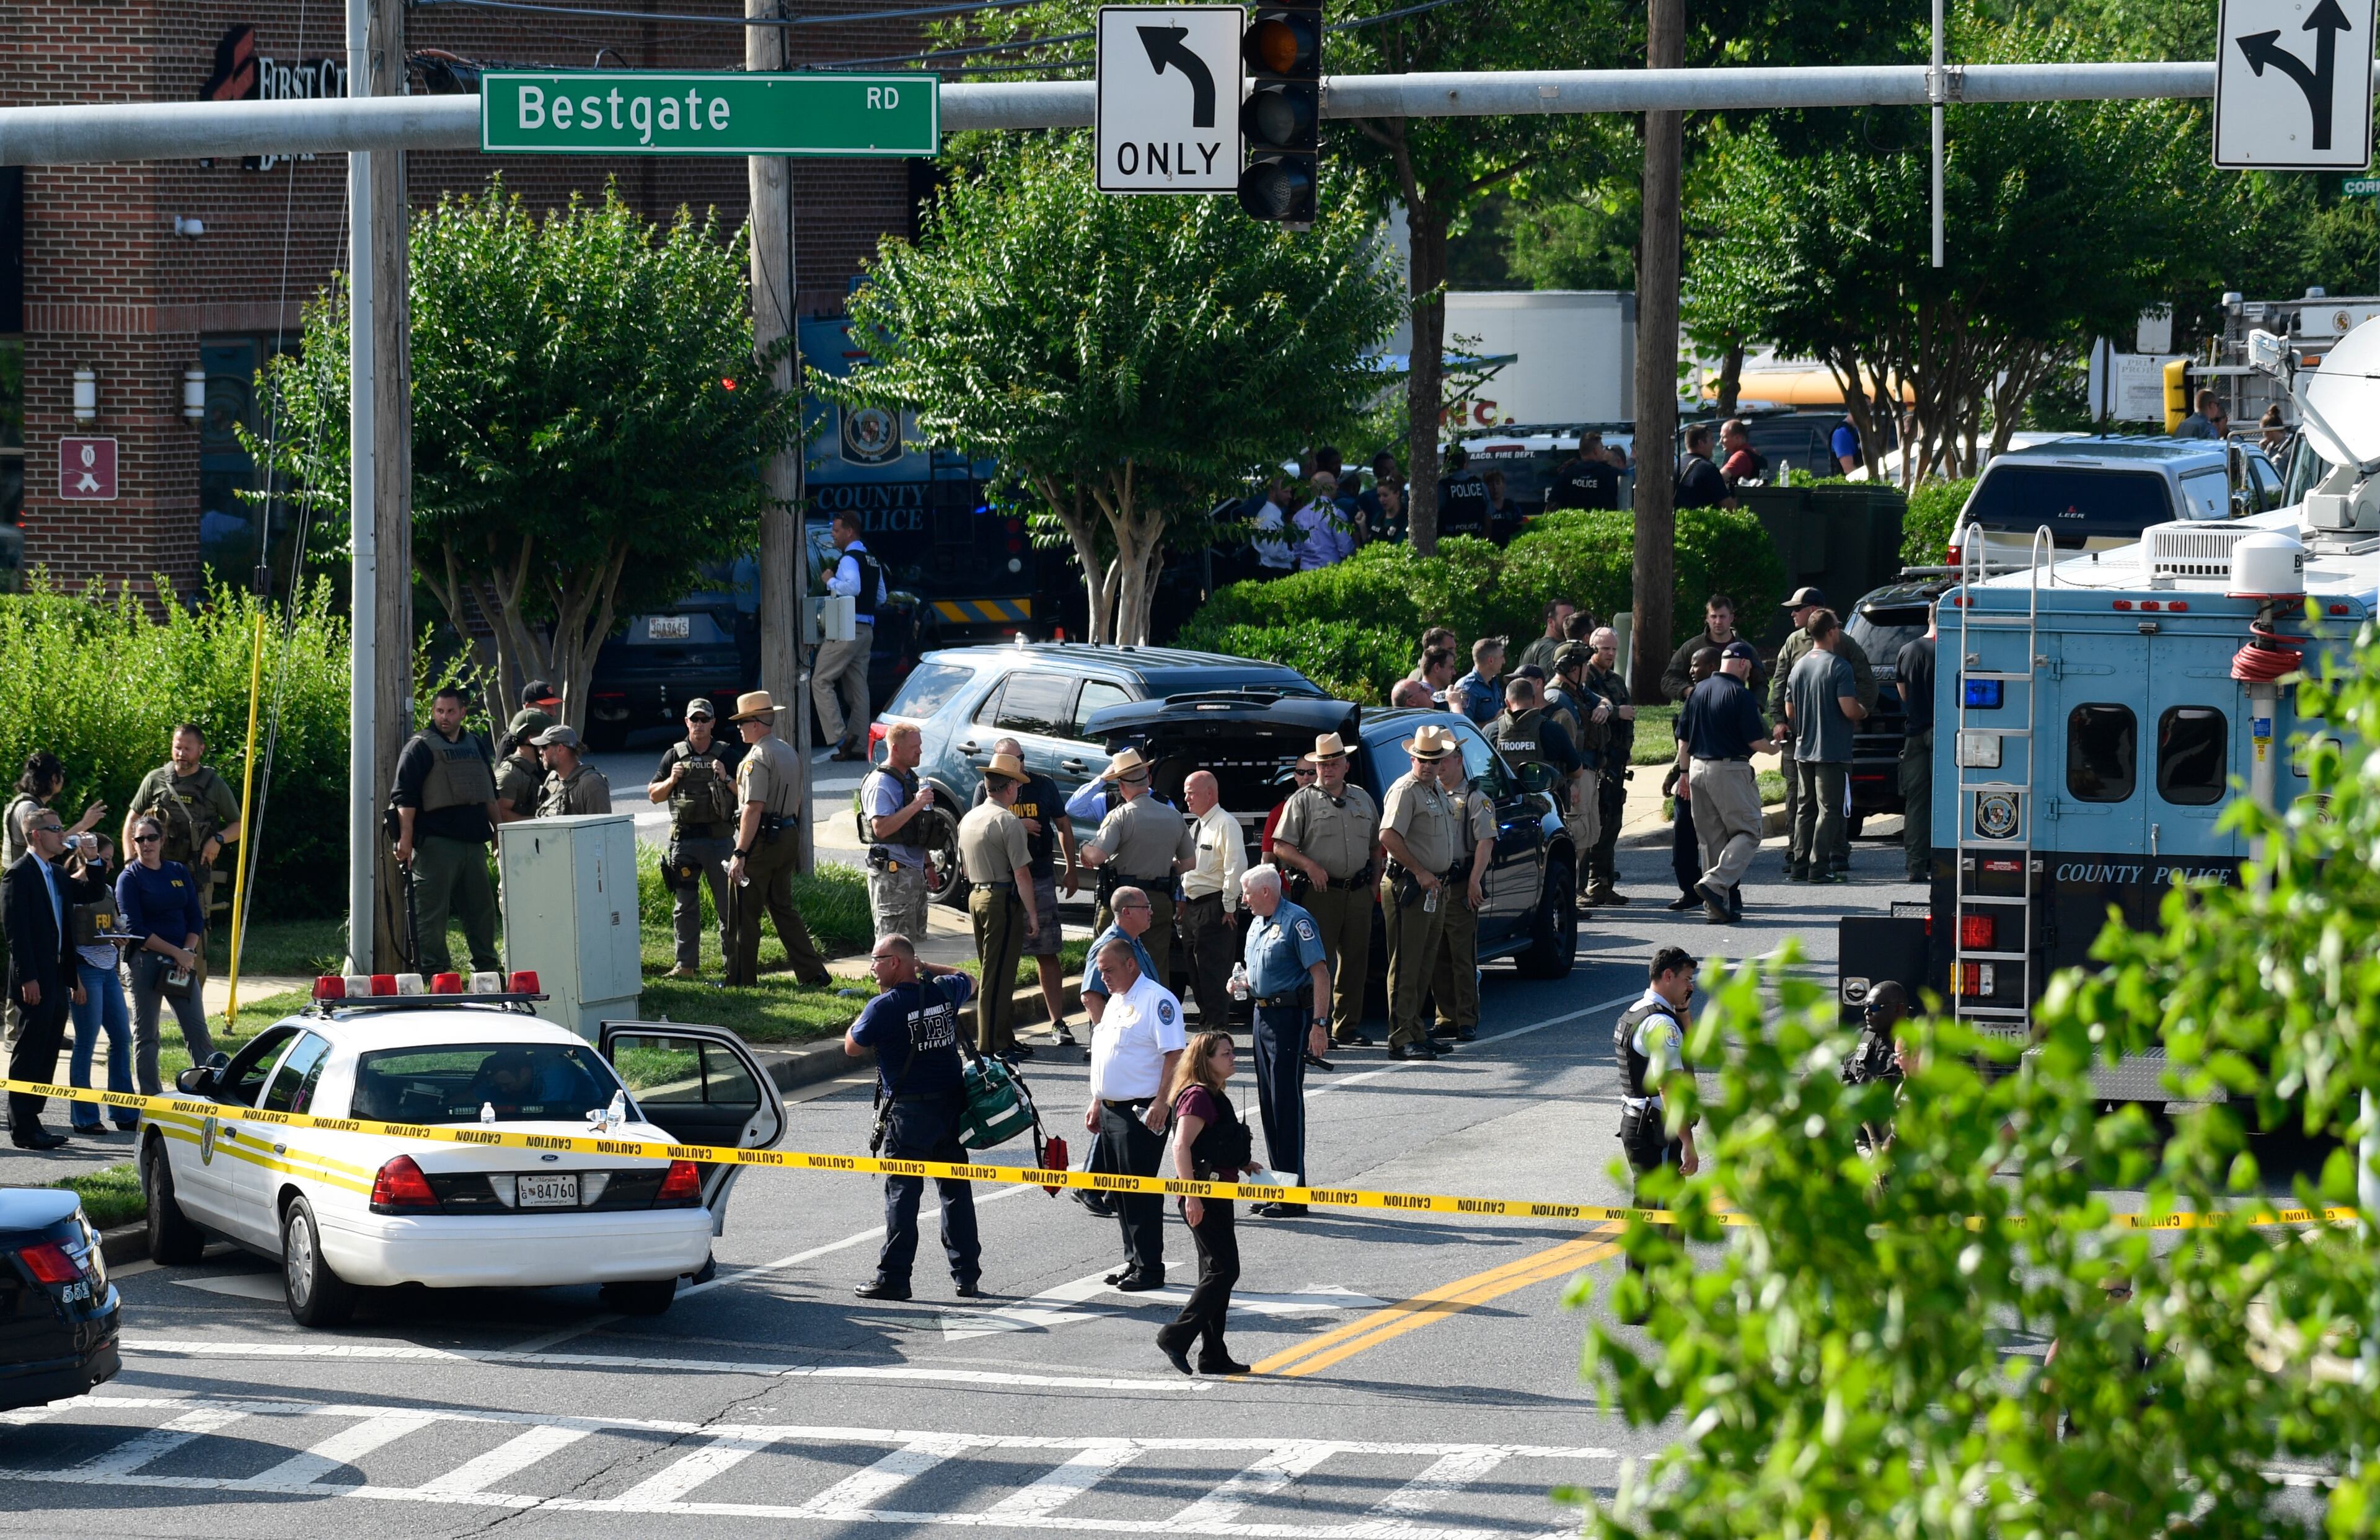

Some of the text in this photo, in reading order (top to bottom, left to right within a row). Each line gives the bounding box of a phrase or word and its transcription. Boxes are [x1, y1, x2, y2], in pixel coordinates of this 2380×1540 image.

[867, 87, 899, 109] RD
[518, 86, 730, 144] Bestgate
[1117, 142, 1221, 175] ONLY
[1450, 483, 1482, 498] POLICE
[1572, 479, 1598, 488] POLICE
[818, 485, 928, 509] COUNTY
[1499, 741, 1536, 751] TROOPER
[1008, 803, 1038, 817] OOPER
[2056, 863, 2144, 883] COUNTY
[95, 914, 111, 929] FBI
[907, 1011, 954, 1045] FIRE
[918, 1032, 955, 1052] EPARTMEN
[32, 1085, 77, 1098] CAUTION
[101, 1093, 148, 1107] CAUTION
[172, 1101, 218, 1115] CAUTION
[242, 1110, 288, 1123] CAUTION
[313, 1118, 359, 1131] CAUTION
[384, 1125, 430, 1138] CAUTION
[455, 1130, 501, 1144] CAUTION
[526, 1137, 571, 1150] CAUTION
[597, 1142, 641, 1155] CAUTION
[668, 1146, 712, 1159] CAUTION
[738, 1151, 783, 1164] CAUTION
[809, 1156, 853, 1169] CAUTION
[880, 1161, 925, 1174] CAUTION
[951, 1166, 996, 1179] CAUTION
[1022, 1171, 1067, 1184] CAUTION
[1094, 1176, 1139, 1189] CAUTION
[1165, 1181, 1211, 1195] CAUTION
[1238, 1186, 1284, 1199] CAUTION
[1311, 1190, 1357, 1203] CAUTION
[1384, 1195, 1430, 1208] CAUTION
[1458, 1200, 1505, 1213] CAUTION
[1531, 1205, 1579, 1217] CAUTION
[537, 1183, 575, 1199] 84760
